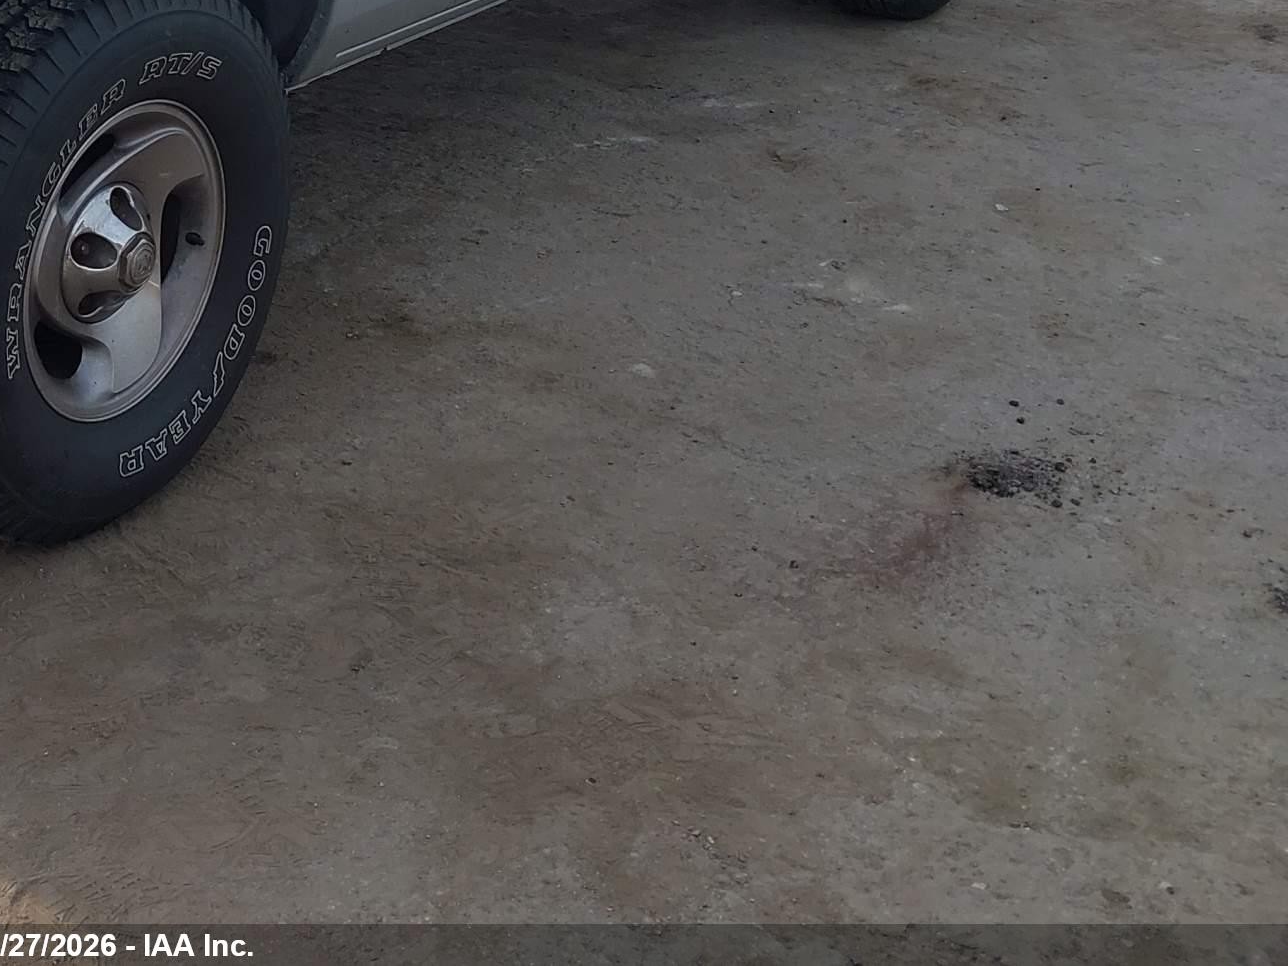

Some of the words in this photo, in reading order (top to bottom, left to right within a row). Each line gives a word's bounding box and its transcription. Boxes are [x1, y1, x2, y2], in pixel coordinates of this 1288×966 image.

[6, 78, 127, 380] WRANGLER
[139, 51, 223, 85] RT/S
[118, 225, 273, 477] GOODYEAR
